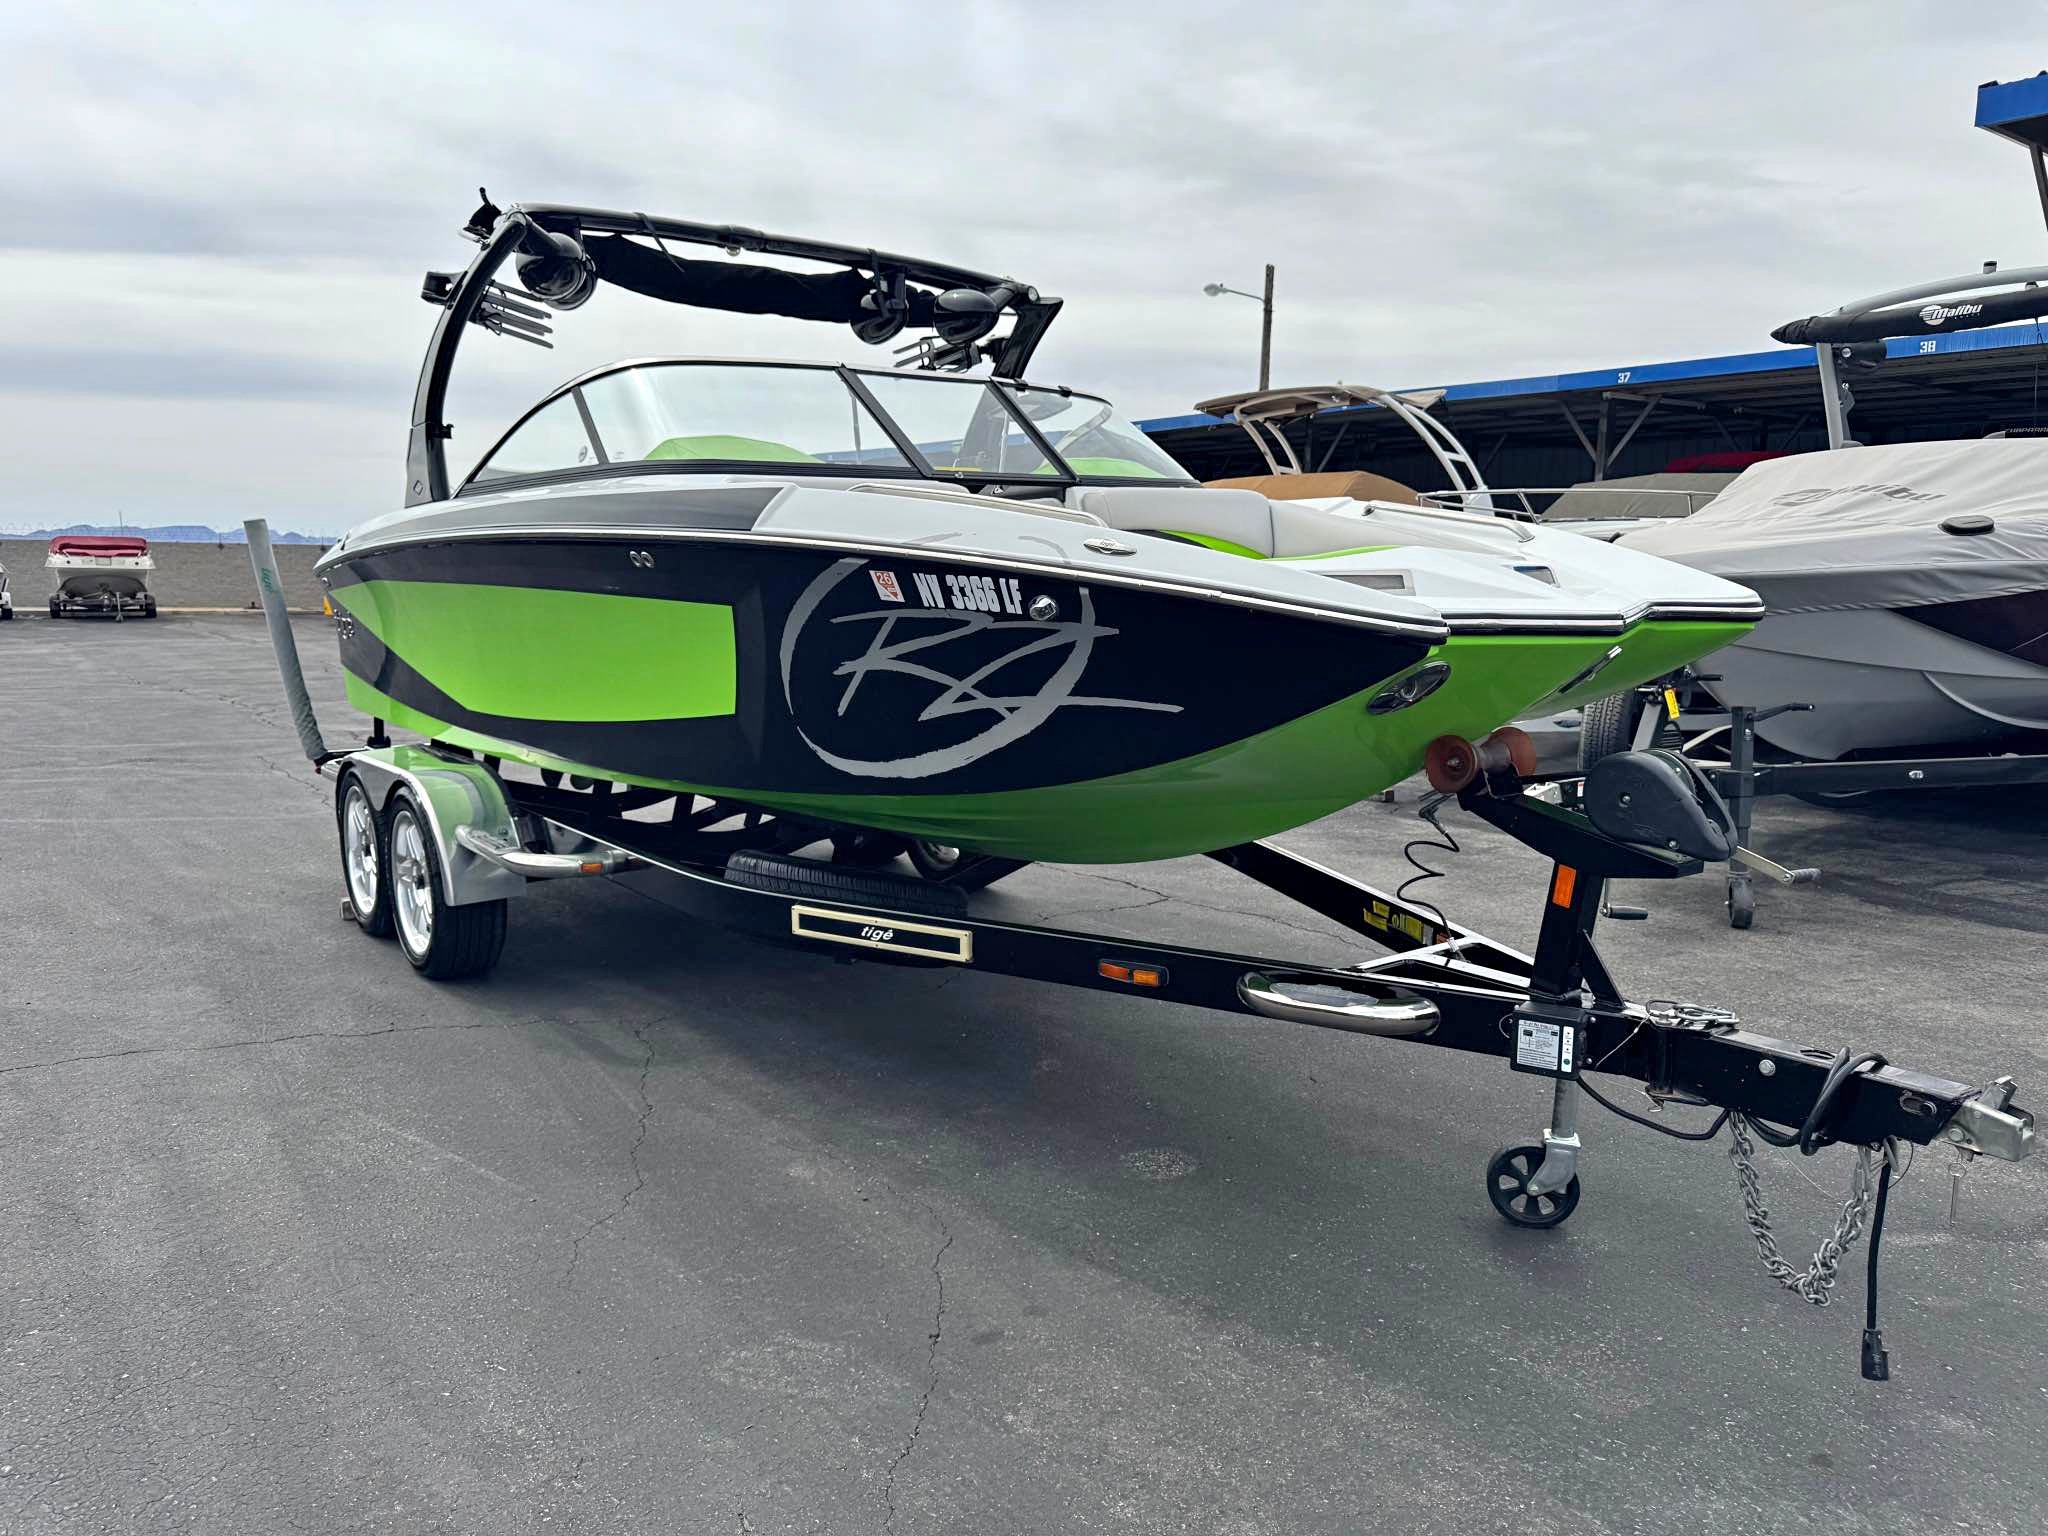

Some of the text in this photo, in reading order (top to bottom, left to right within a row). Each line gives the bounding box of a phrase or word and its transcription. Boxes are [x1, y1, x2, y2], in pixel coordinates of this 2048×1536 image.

[1931, 304, 1983, 319] Malibu
[1920, 340, 1937, 353] 38
[1617, 371, 1632, 384] 37
[876, 572, 892, 585] 26
[912, 572, 1023, 615] NV 3366 LF
